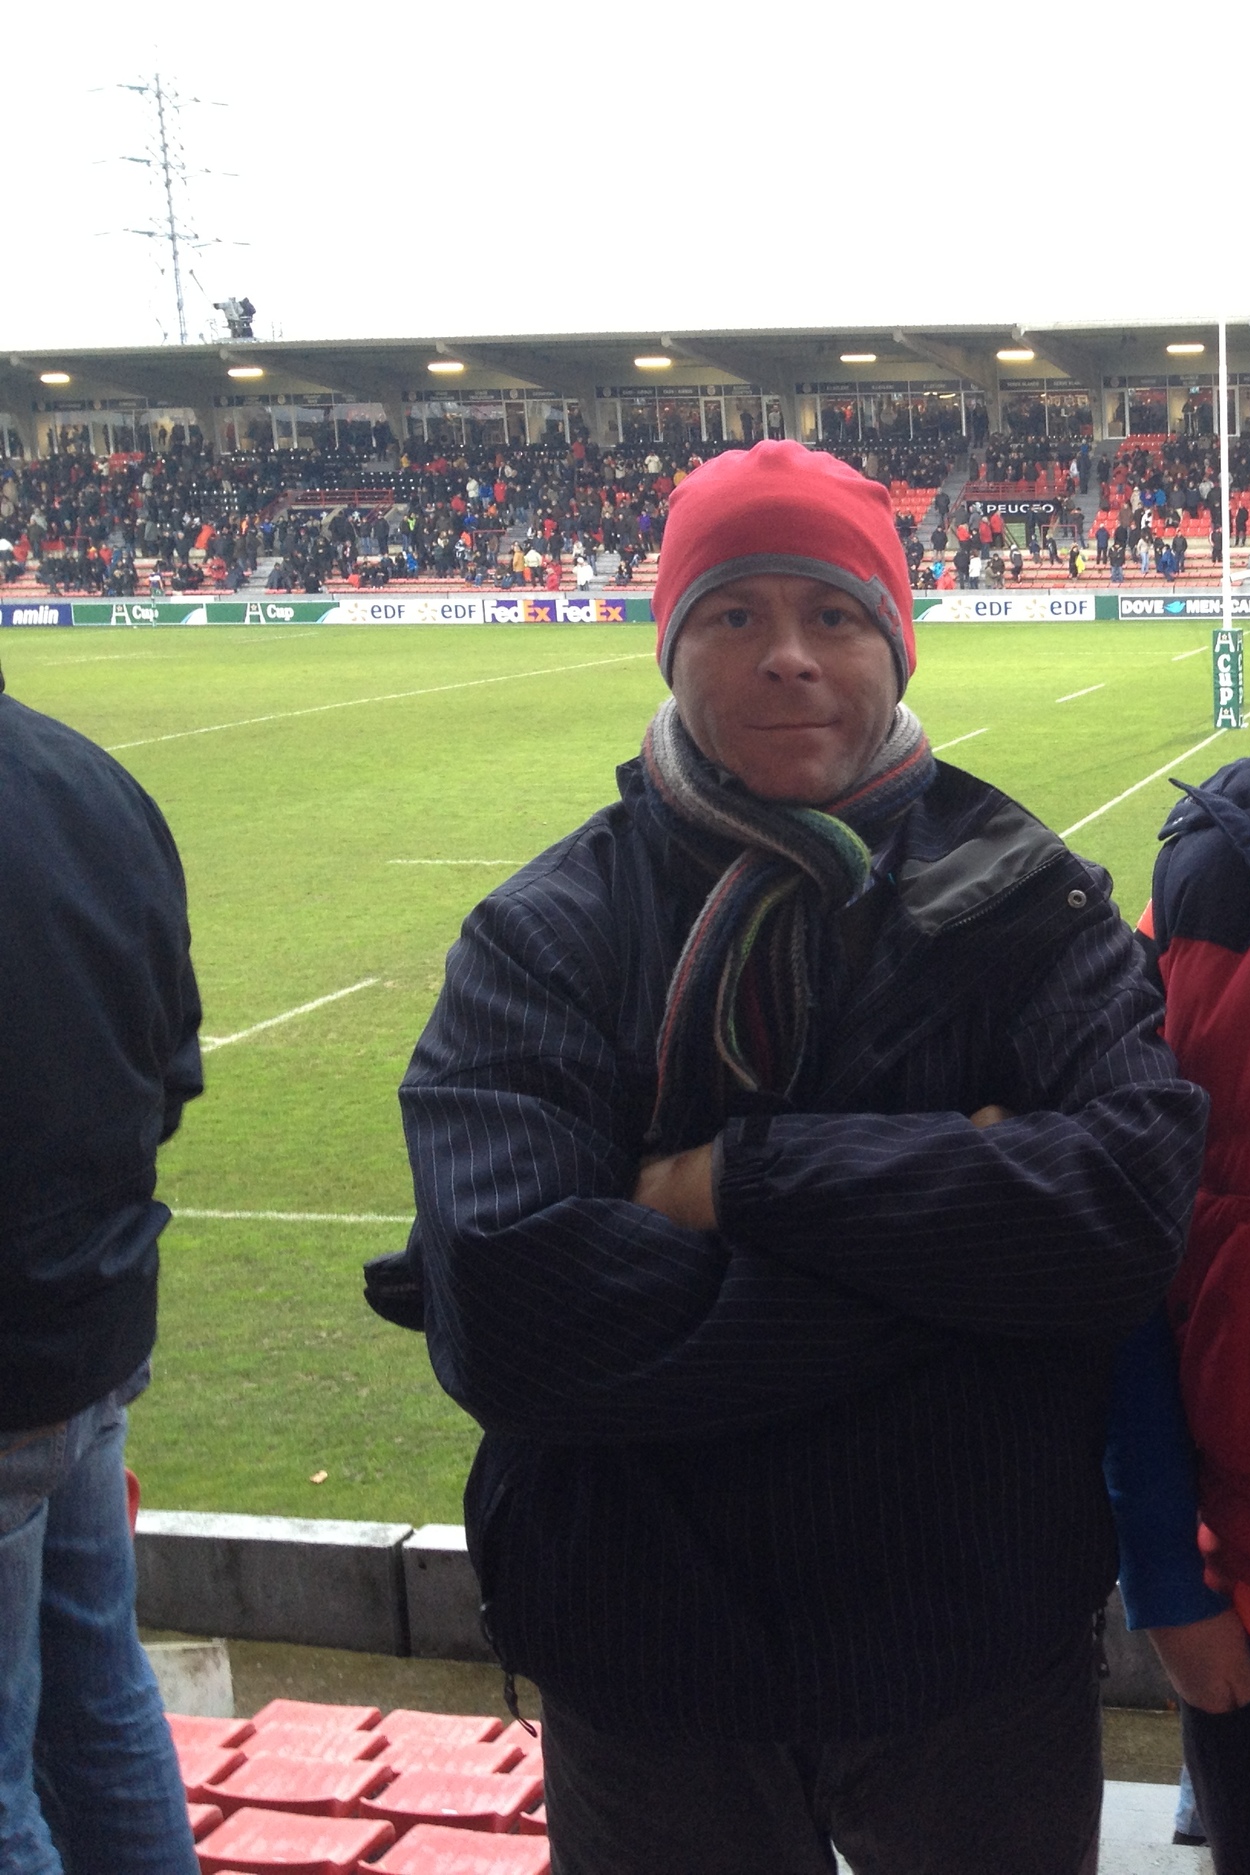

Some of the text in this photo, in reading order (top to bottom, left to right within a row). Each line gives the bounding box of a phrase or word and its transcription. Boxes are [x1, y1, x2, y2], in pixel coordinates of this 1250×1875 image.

[12, 605, 59, 625] amlin
[267, 604, 295, 621] Cup
[484, 599, 624, 622] FedEx FedEx
[1121, 600, 1164, 614] DOVE
